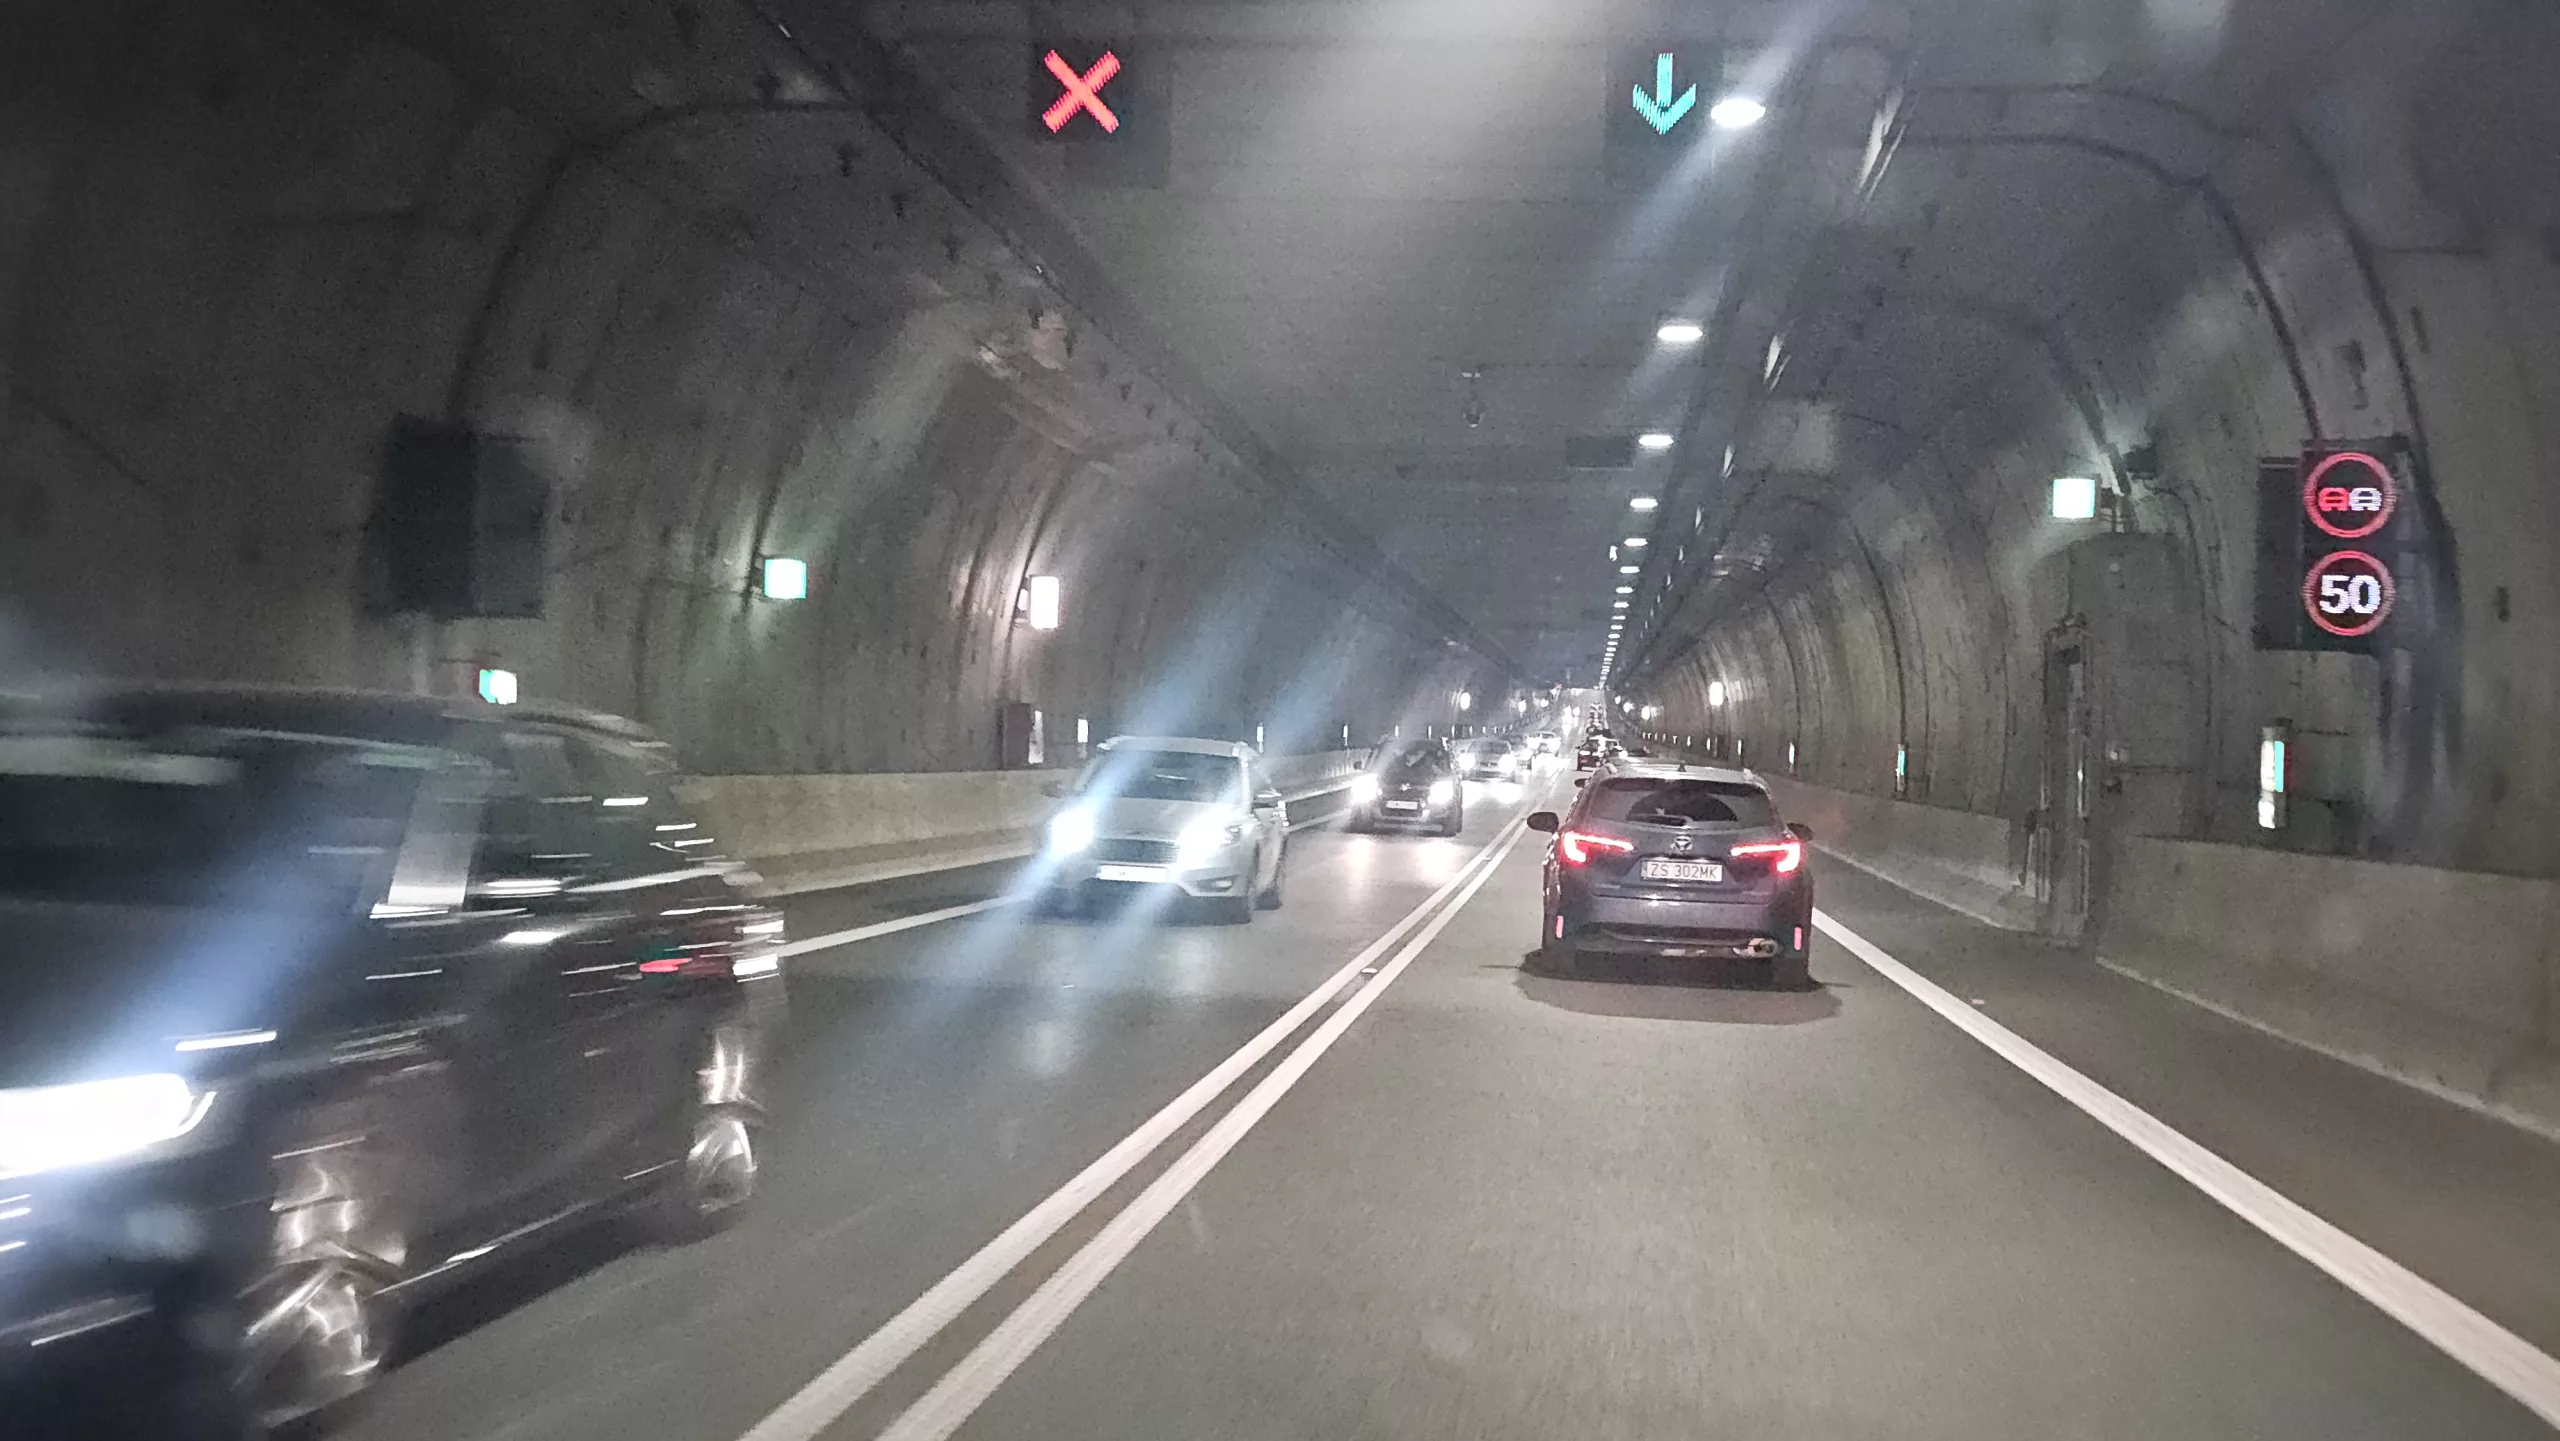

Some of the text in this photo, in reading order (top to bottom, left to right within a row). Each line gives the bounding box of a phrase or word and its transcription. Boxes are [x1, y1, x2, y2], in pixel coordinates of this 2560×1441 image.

[2319, 574, 2382, 614] 50
[1650, 863, 1718, 880] ZS 302MK
